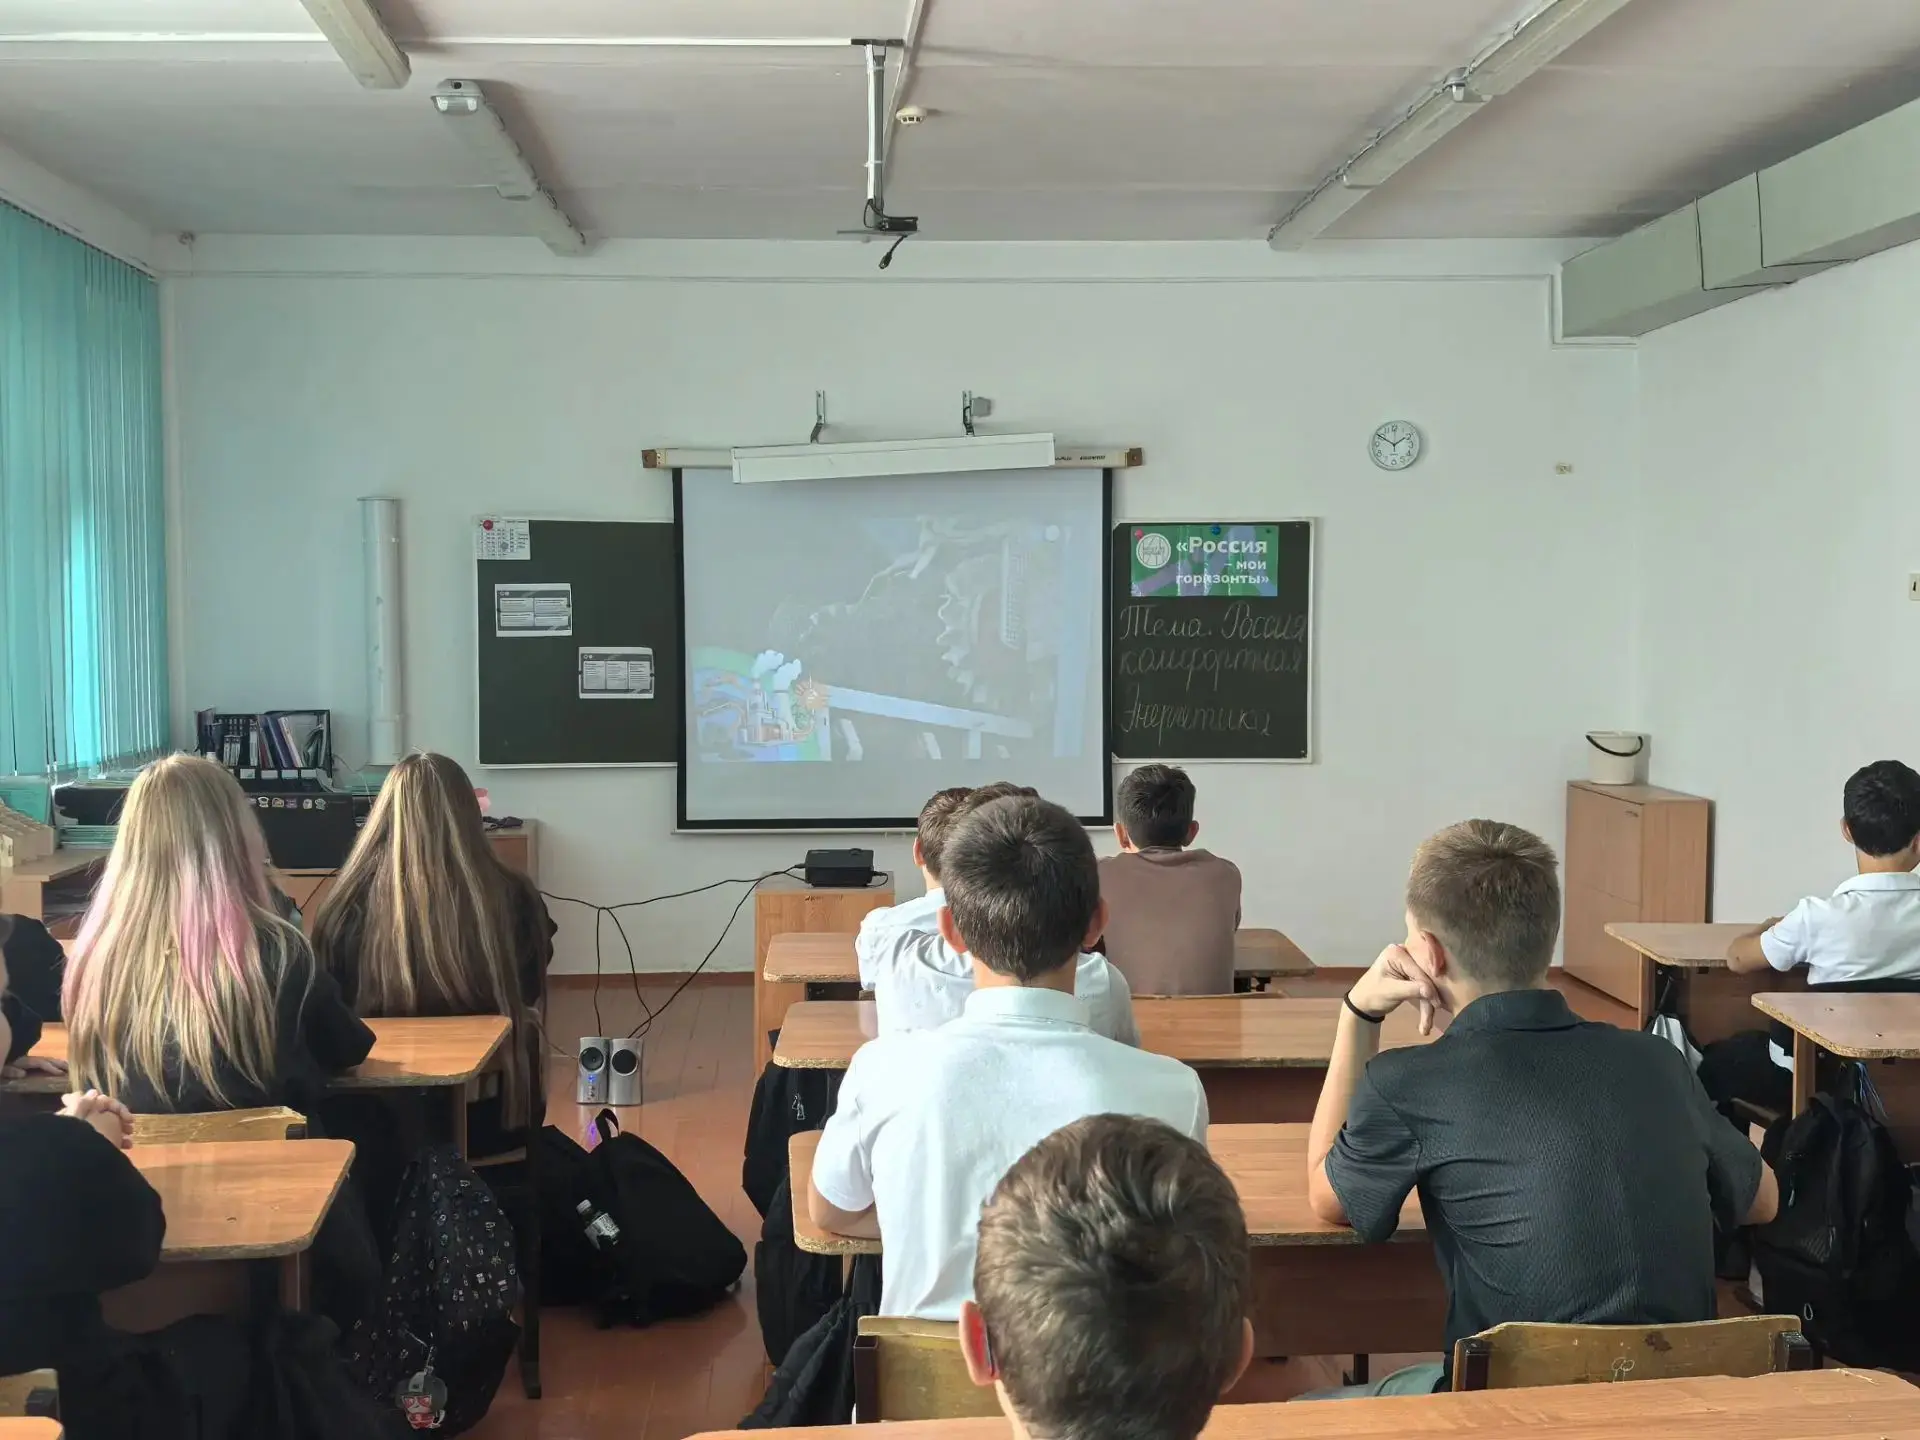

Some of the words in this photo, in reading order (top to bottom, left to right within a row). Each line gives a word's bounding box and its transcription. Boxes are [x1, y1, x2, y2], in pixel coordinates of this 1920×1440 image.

[1176, 536, 1267, 553] «Россия
[1236, 561, 1266, 570] мои
[1176, 575, 1269, 586] горизонты»
[1120, 604, 1212, 640] Тема.
[1221, 600, 1307, 642] Россия
